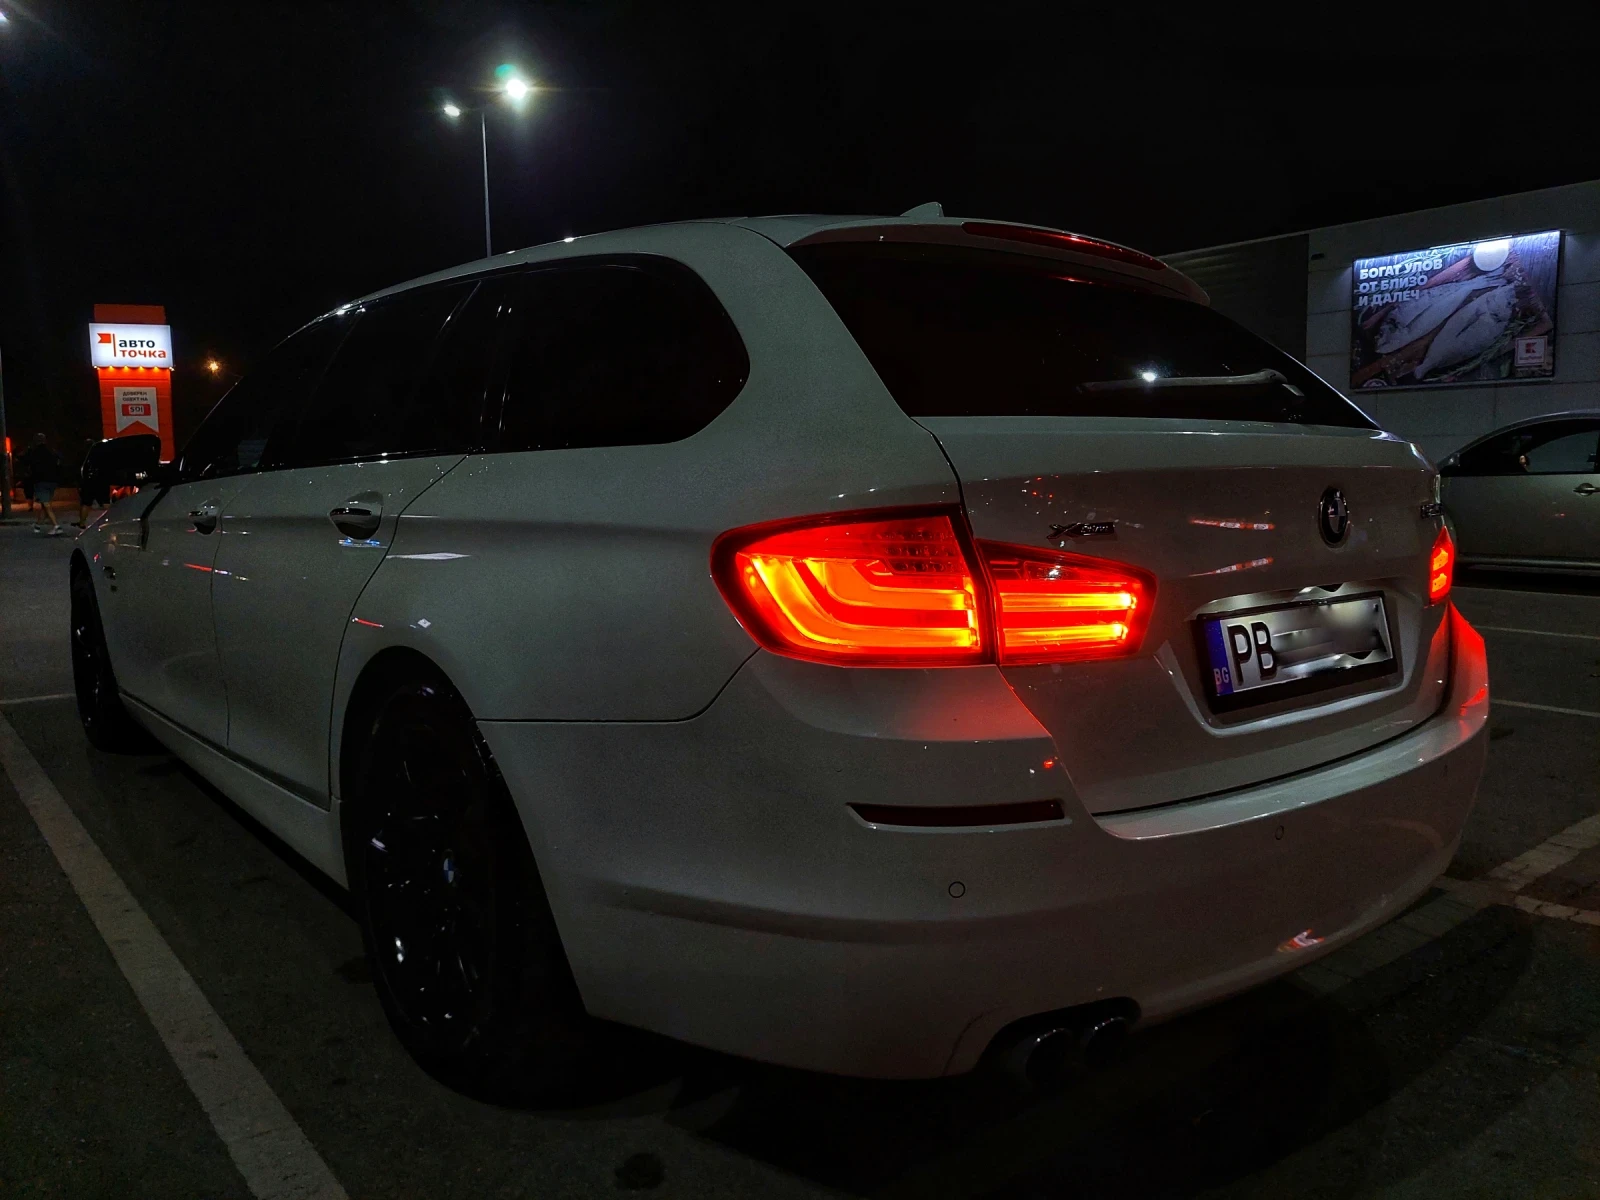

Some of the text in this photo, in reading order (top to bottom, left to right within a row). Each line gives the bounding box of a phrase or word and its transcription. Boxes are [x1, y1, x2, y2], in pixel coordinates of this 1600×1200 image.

[1360, 258, 1443, 280] БОГАТ УЛОВ
[1359, 274, 1429, 293] ОТ БЛИЗО
[1358, 289, 1420, 307] И ДАЛЕЧ
[118, 339, 156, 348] авто
[119, 349, 167, 358] точка
[1213, 667, 1230, 685] BG
